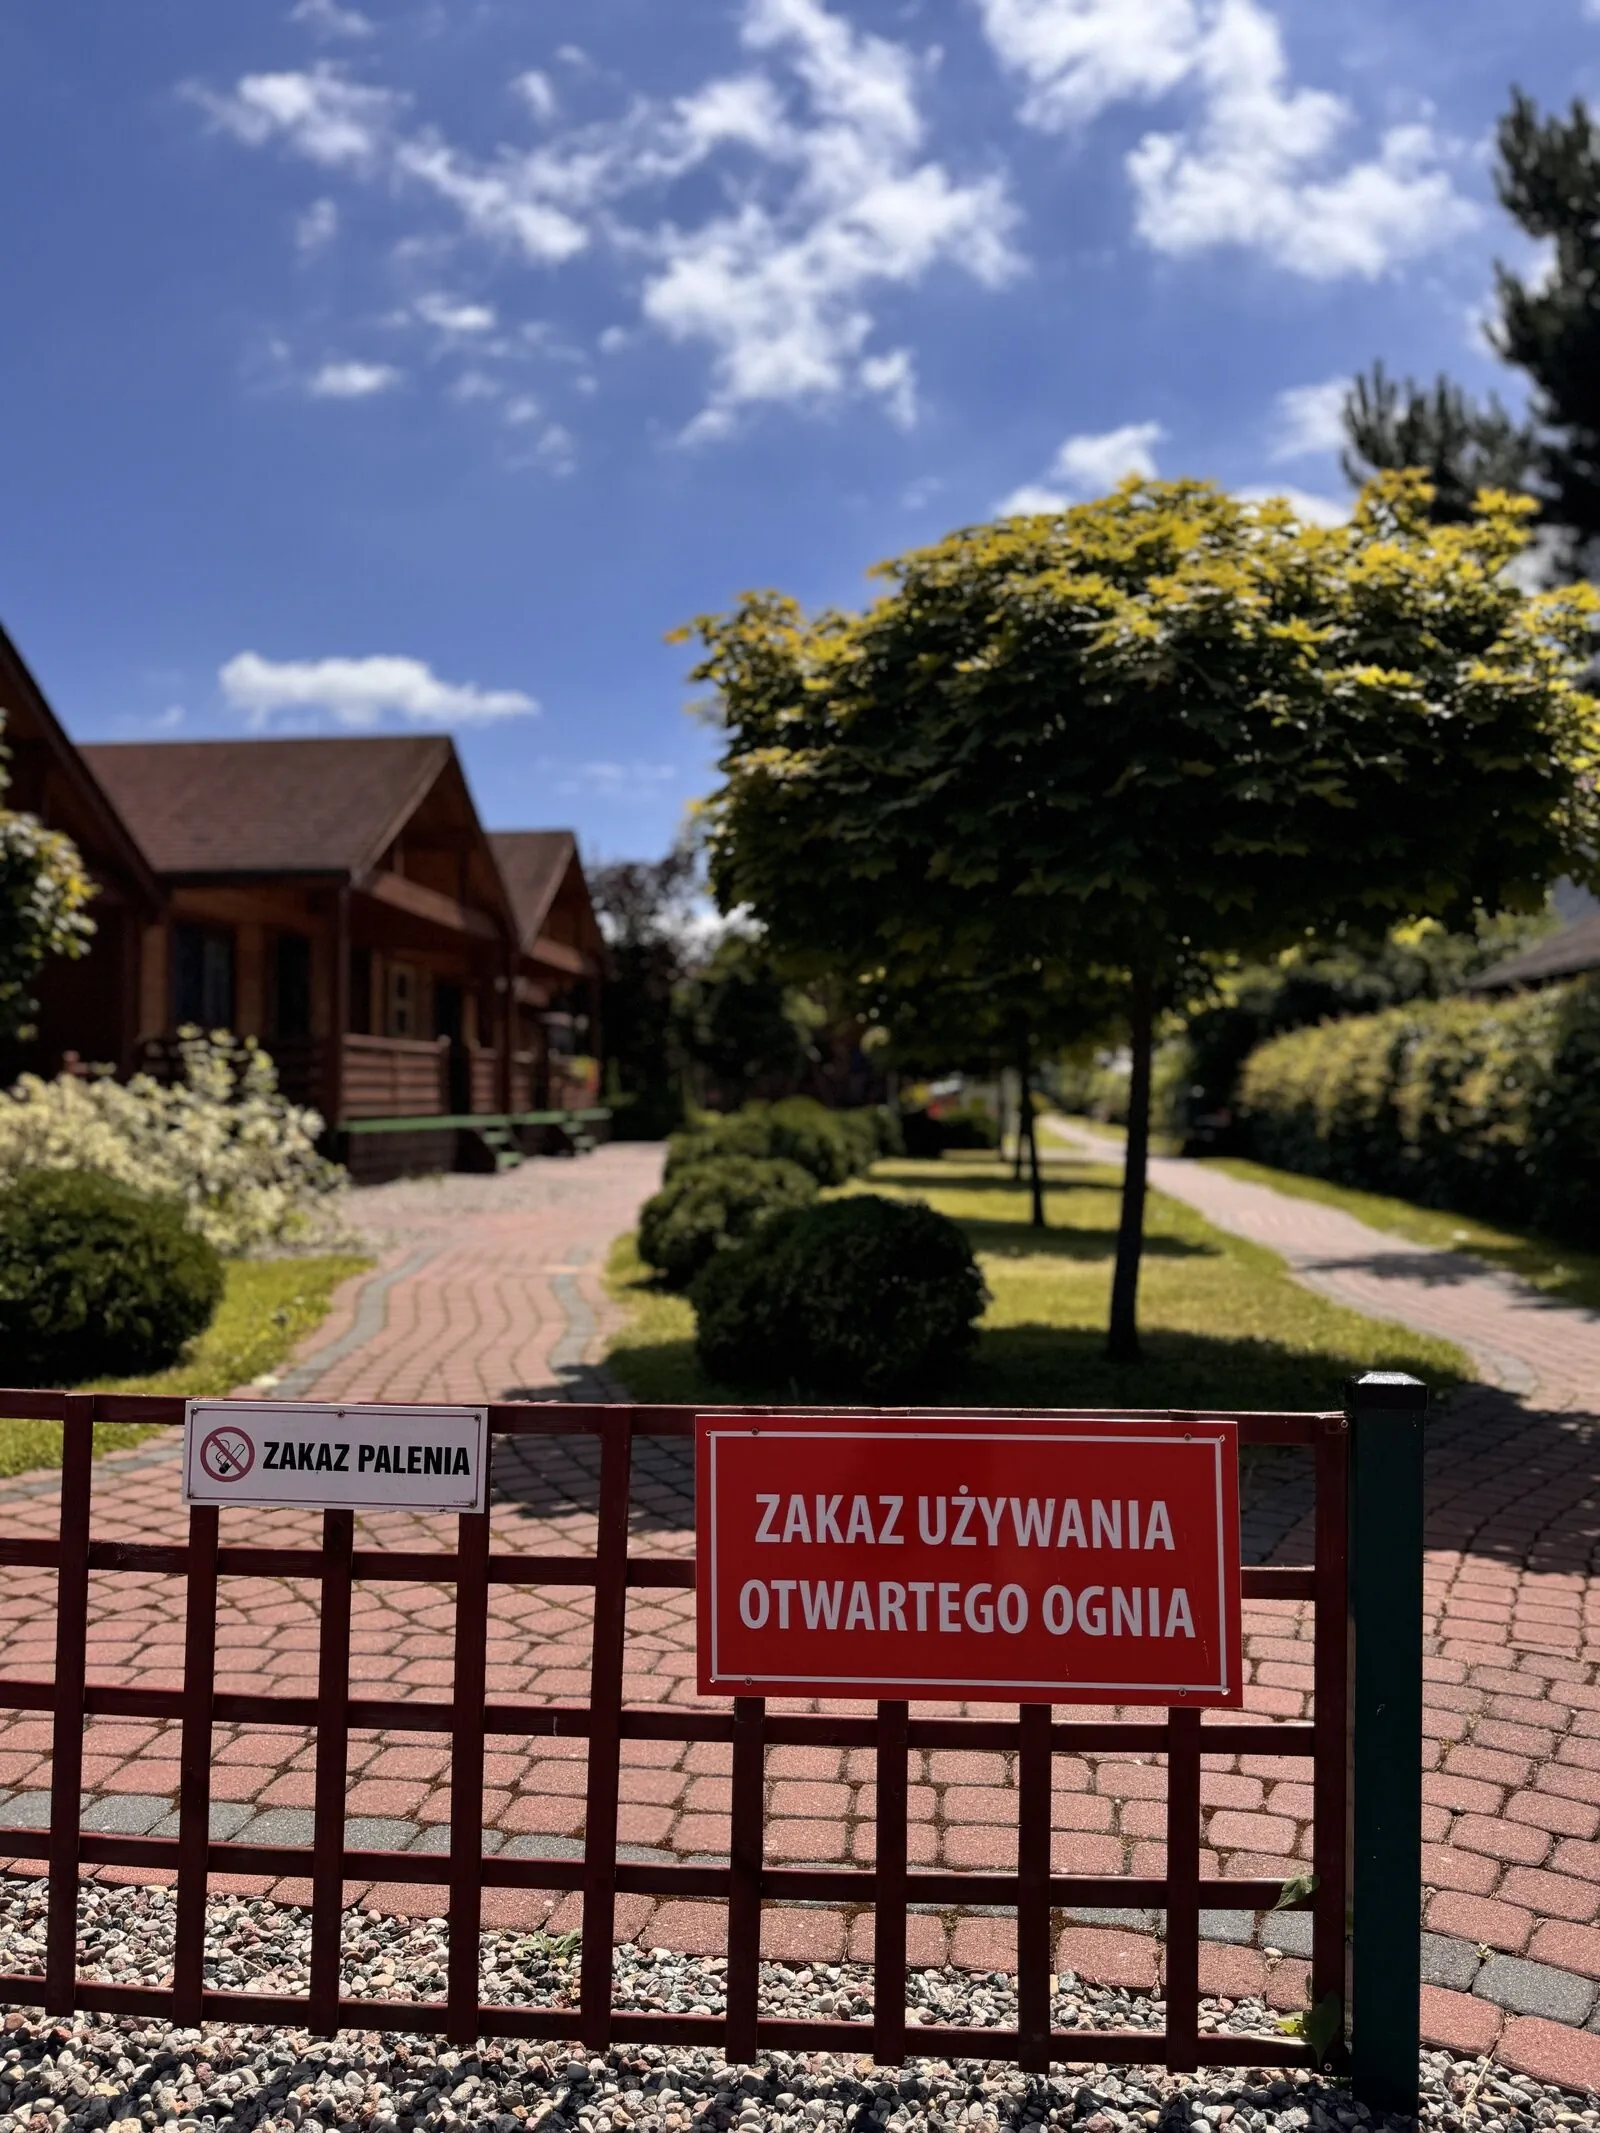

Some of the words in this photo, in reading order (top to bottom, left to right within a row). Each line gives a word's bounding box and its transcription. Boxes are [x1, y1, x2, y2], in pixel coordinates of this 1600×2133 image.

[264, 1442, 350, 1471] ZAKAZ
[358, 1445, 470, 1475] PALENIA
[755, 1493, 905, 1544] ZAKAZ
[919, 1485, 1175, 1550] UŻYWANIA
[740, 1579, 1029, 1633] OTWARTEGO
[1043, 1585, 1196, 1638] OGNIA
